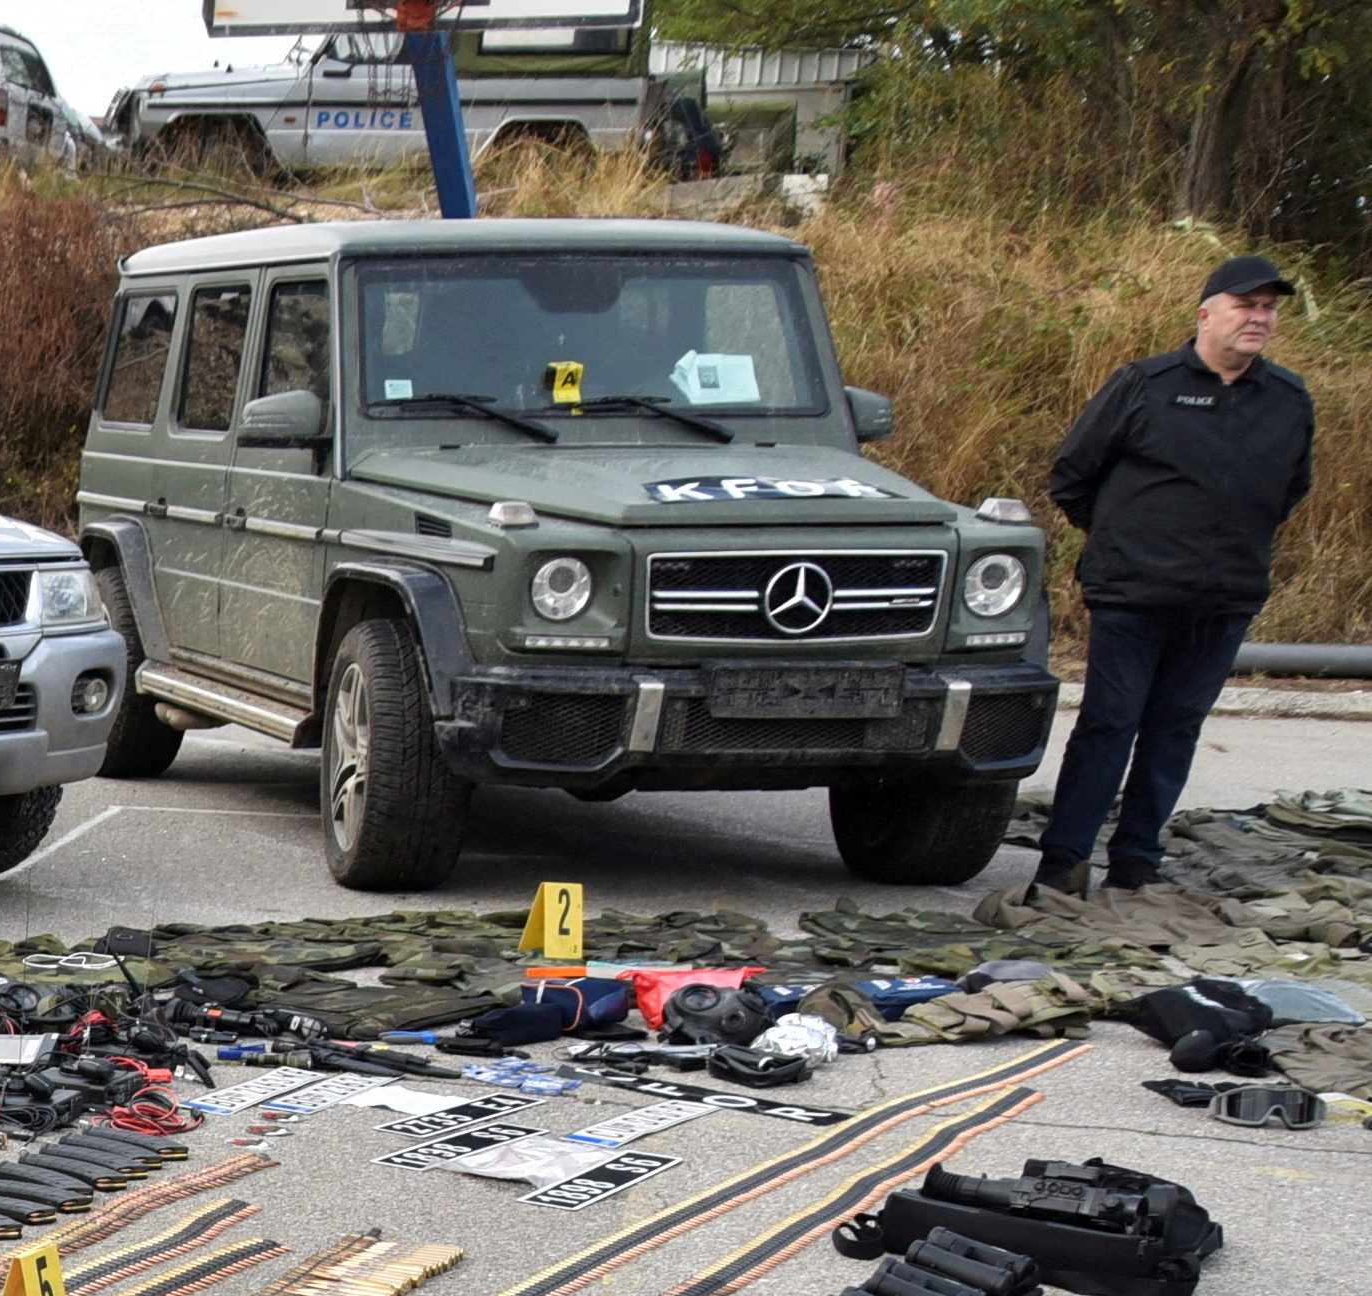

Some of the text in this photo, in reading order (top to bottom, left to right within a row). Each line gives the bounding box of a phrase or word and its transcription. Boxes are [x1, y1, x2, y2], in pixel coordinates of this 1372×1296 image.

[317, 111, 413, 129] POLICE
[561, 371, 576, 387] A
[1176, 394, 1215, 406] POLICE
[657, 479, 893, 501] KFOR
[558, 888, 571, 936] 2
[392, 1112, 474, 1136] 2735
[470, 1126, 528, 1142] S6
[536, 1155, 663, 1206] 1898 S6
